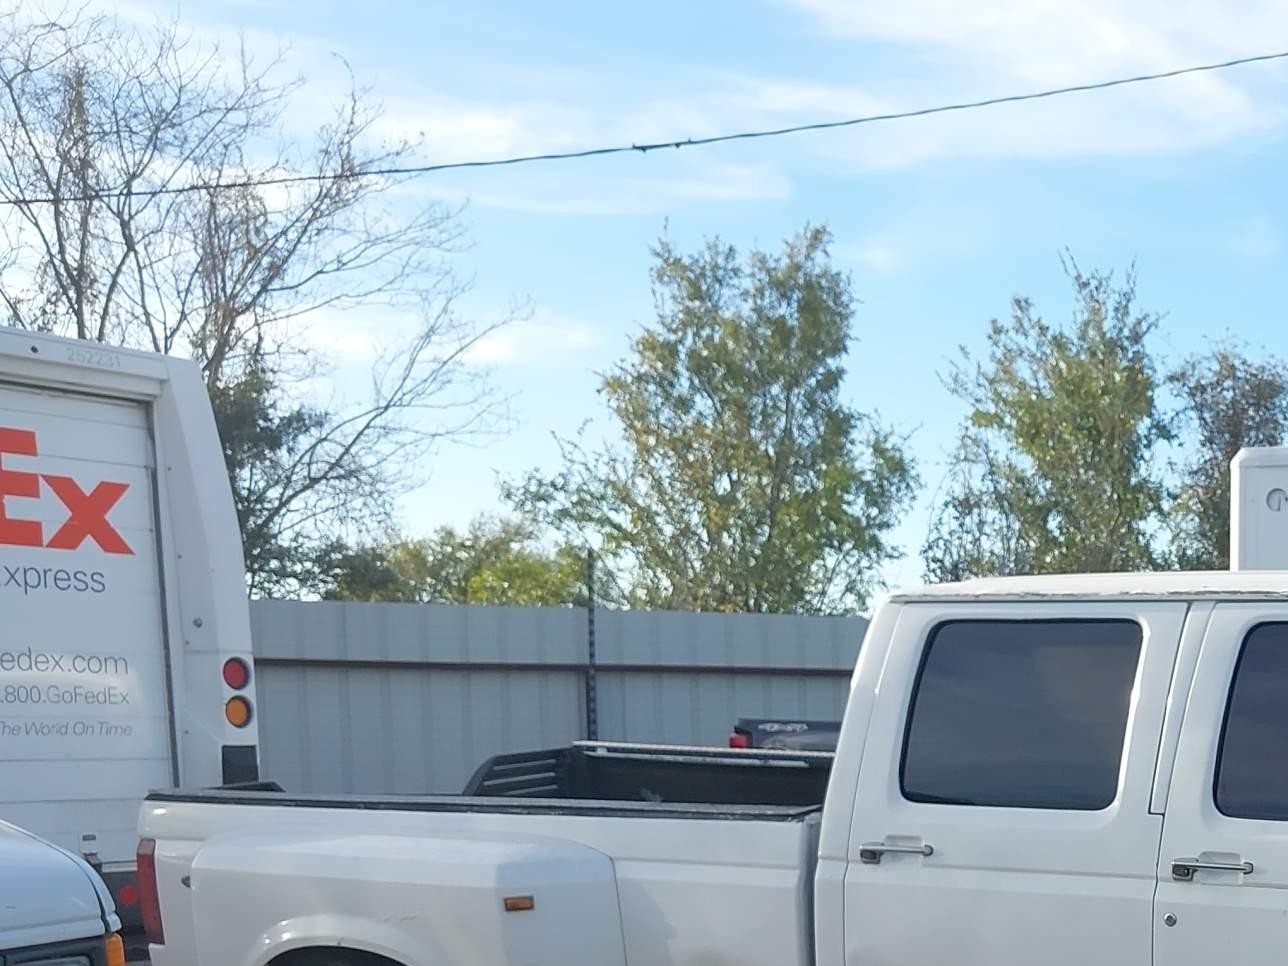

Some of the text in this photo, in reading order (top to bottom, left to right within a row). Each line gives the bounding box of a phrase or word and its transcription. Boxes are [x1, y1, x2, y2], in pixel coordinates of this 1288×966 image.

[0, 565, 106, 595] xpress
[72, 720, 95, 737] On
[97, 720, 133, 737] Time
